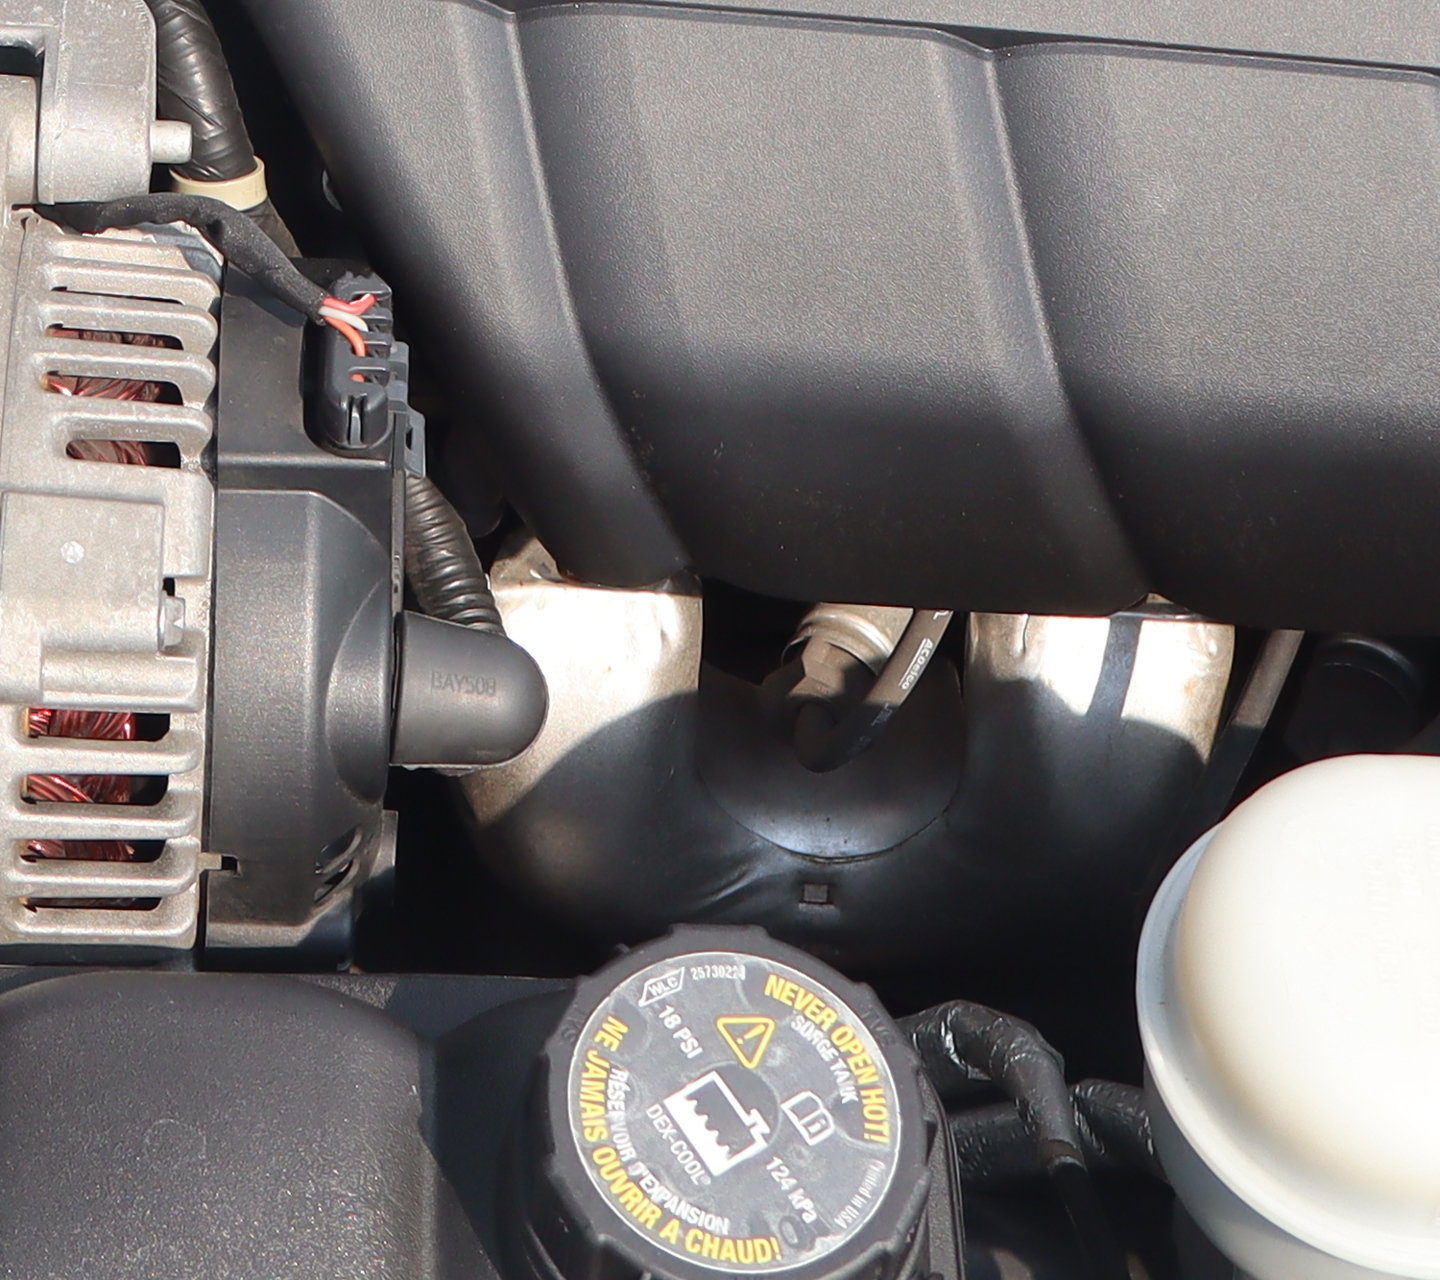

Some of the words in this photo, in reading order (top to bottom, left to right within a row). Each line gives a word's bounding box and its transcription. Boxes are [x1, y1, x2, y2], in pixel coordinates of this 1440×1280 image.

[649, 979, 679, 998] WLC
[597, 1016, 629, 1052] NE
[658, 1005, 680, 1030] 18
[672, 1025, 704, 1059] PSI
[765, 974, 838, 1031] NEVER
[830, 1020, 884, 1085] OPEN
[860, 1086, 890, 1144] HOT!
[578, 1049, 610, 1142] JAMAIS
[592, 1145, 663, 1230] OUVRIR
[766, 1158, 791, 1191] 124
[787, 1186, 818, 1224] kPa
[660, 1220, 680, 1246] A
[834, 1204, 860, 1230] USA
[685, 1230, 783, 1264] CHAUD!
